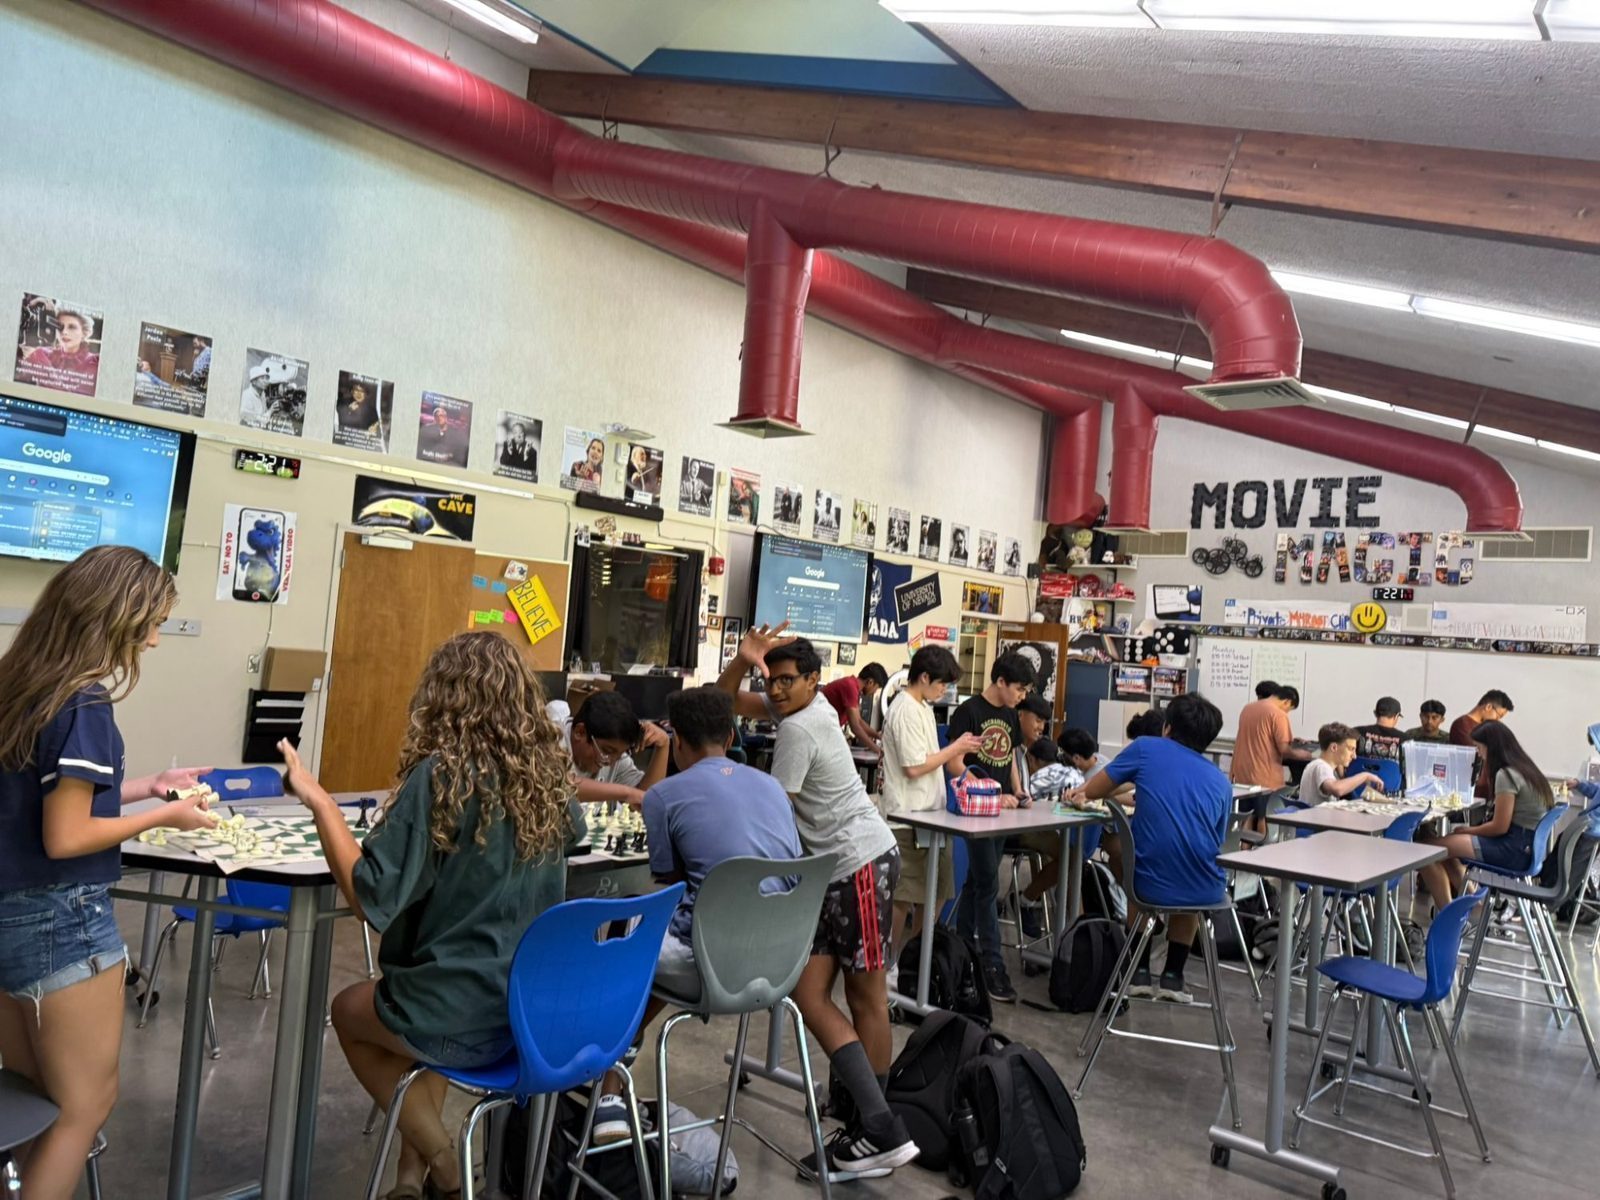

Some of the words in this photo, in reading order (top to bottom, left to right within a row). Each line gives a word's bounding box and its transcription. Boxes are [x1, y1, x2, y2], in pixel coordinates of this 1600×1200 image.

[22, 442, 72, 464] Google
[437, 498, 473, 515] CAVE
[449, 493, 464, 501] THE
[1190, 475, 1382, 529] MOVIE
[226, 531, 233, 544] TO
[286, 527, 294, 552] VIDEO
[225, 544, 232, 558] NO
[1274, 530, 1475, 586] MAGIC
[805, 566, 825, 579] Google
[900, 581, 935, 602] UNIVERSITY
[513, 580, 553, 639] BELIEVE
[1247, 607, 1287, 626] Private
